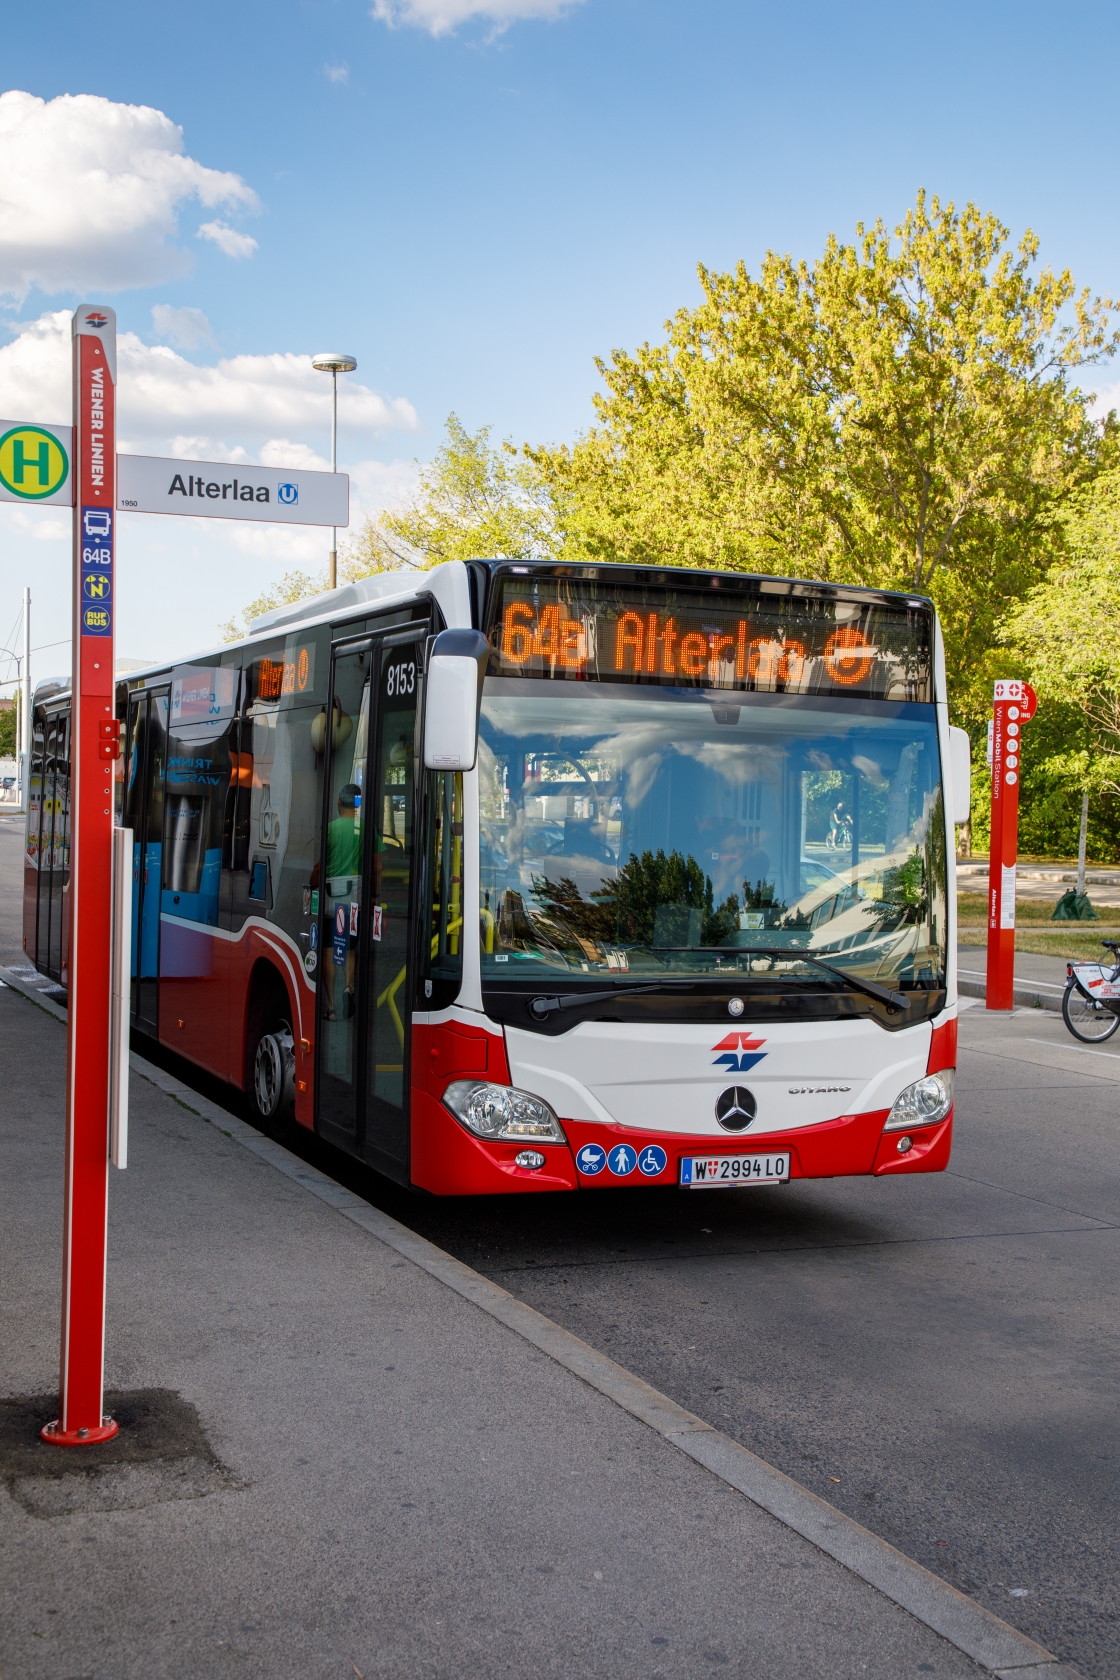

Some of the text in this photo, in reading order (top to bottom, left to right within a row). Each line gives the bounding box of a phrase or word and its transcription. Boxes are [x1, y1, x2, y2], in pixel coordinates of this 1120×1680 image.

[91, 367, 104, 487] WIENER LINIEN
[13, 440, 50, 486] H
[168, 474, 271, 503] Alterlaa
[121, 499, 138, 507] 1950
[82, 547, 111, 565] 64B
[90, 582, 104, 598] N
[86, 611, 107, 619] RUF
[86, 618, 107, 627] BUS
[503, 602, 588, 667] 64B
[615, 611, 805, 681] Alterlaa
[387, 661, 415, 696] 8153
[993, 764, 1001, 799] Station
[788, 1085, 852, 1095] CITARO
[695, 1160, 707, 1180] W
[720, 1158, 762, 1179] 2994
